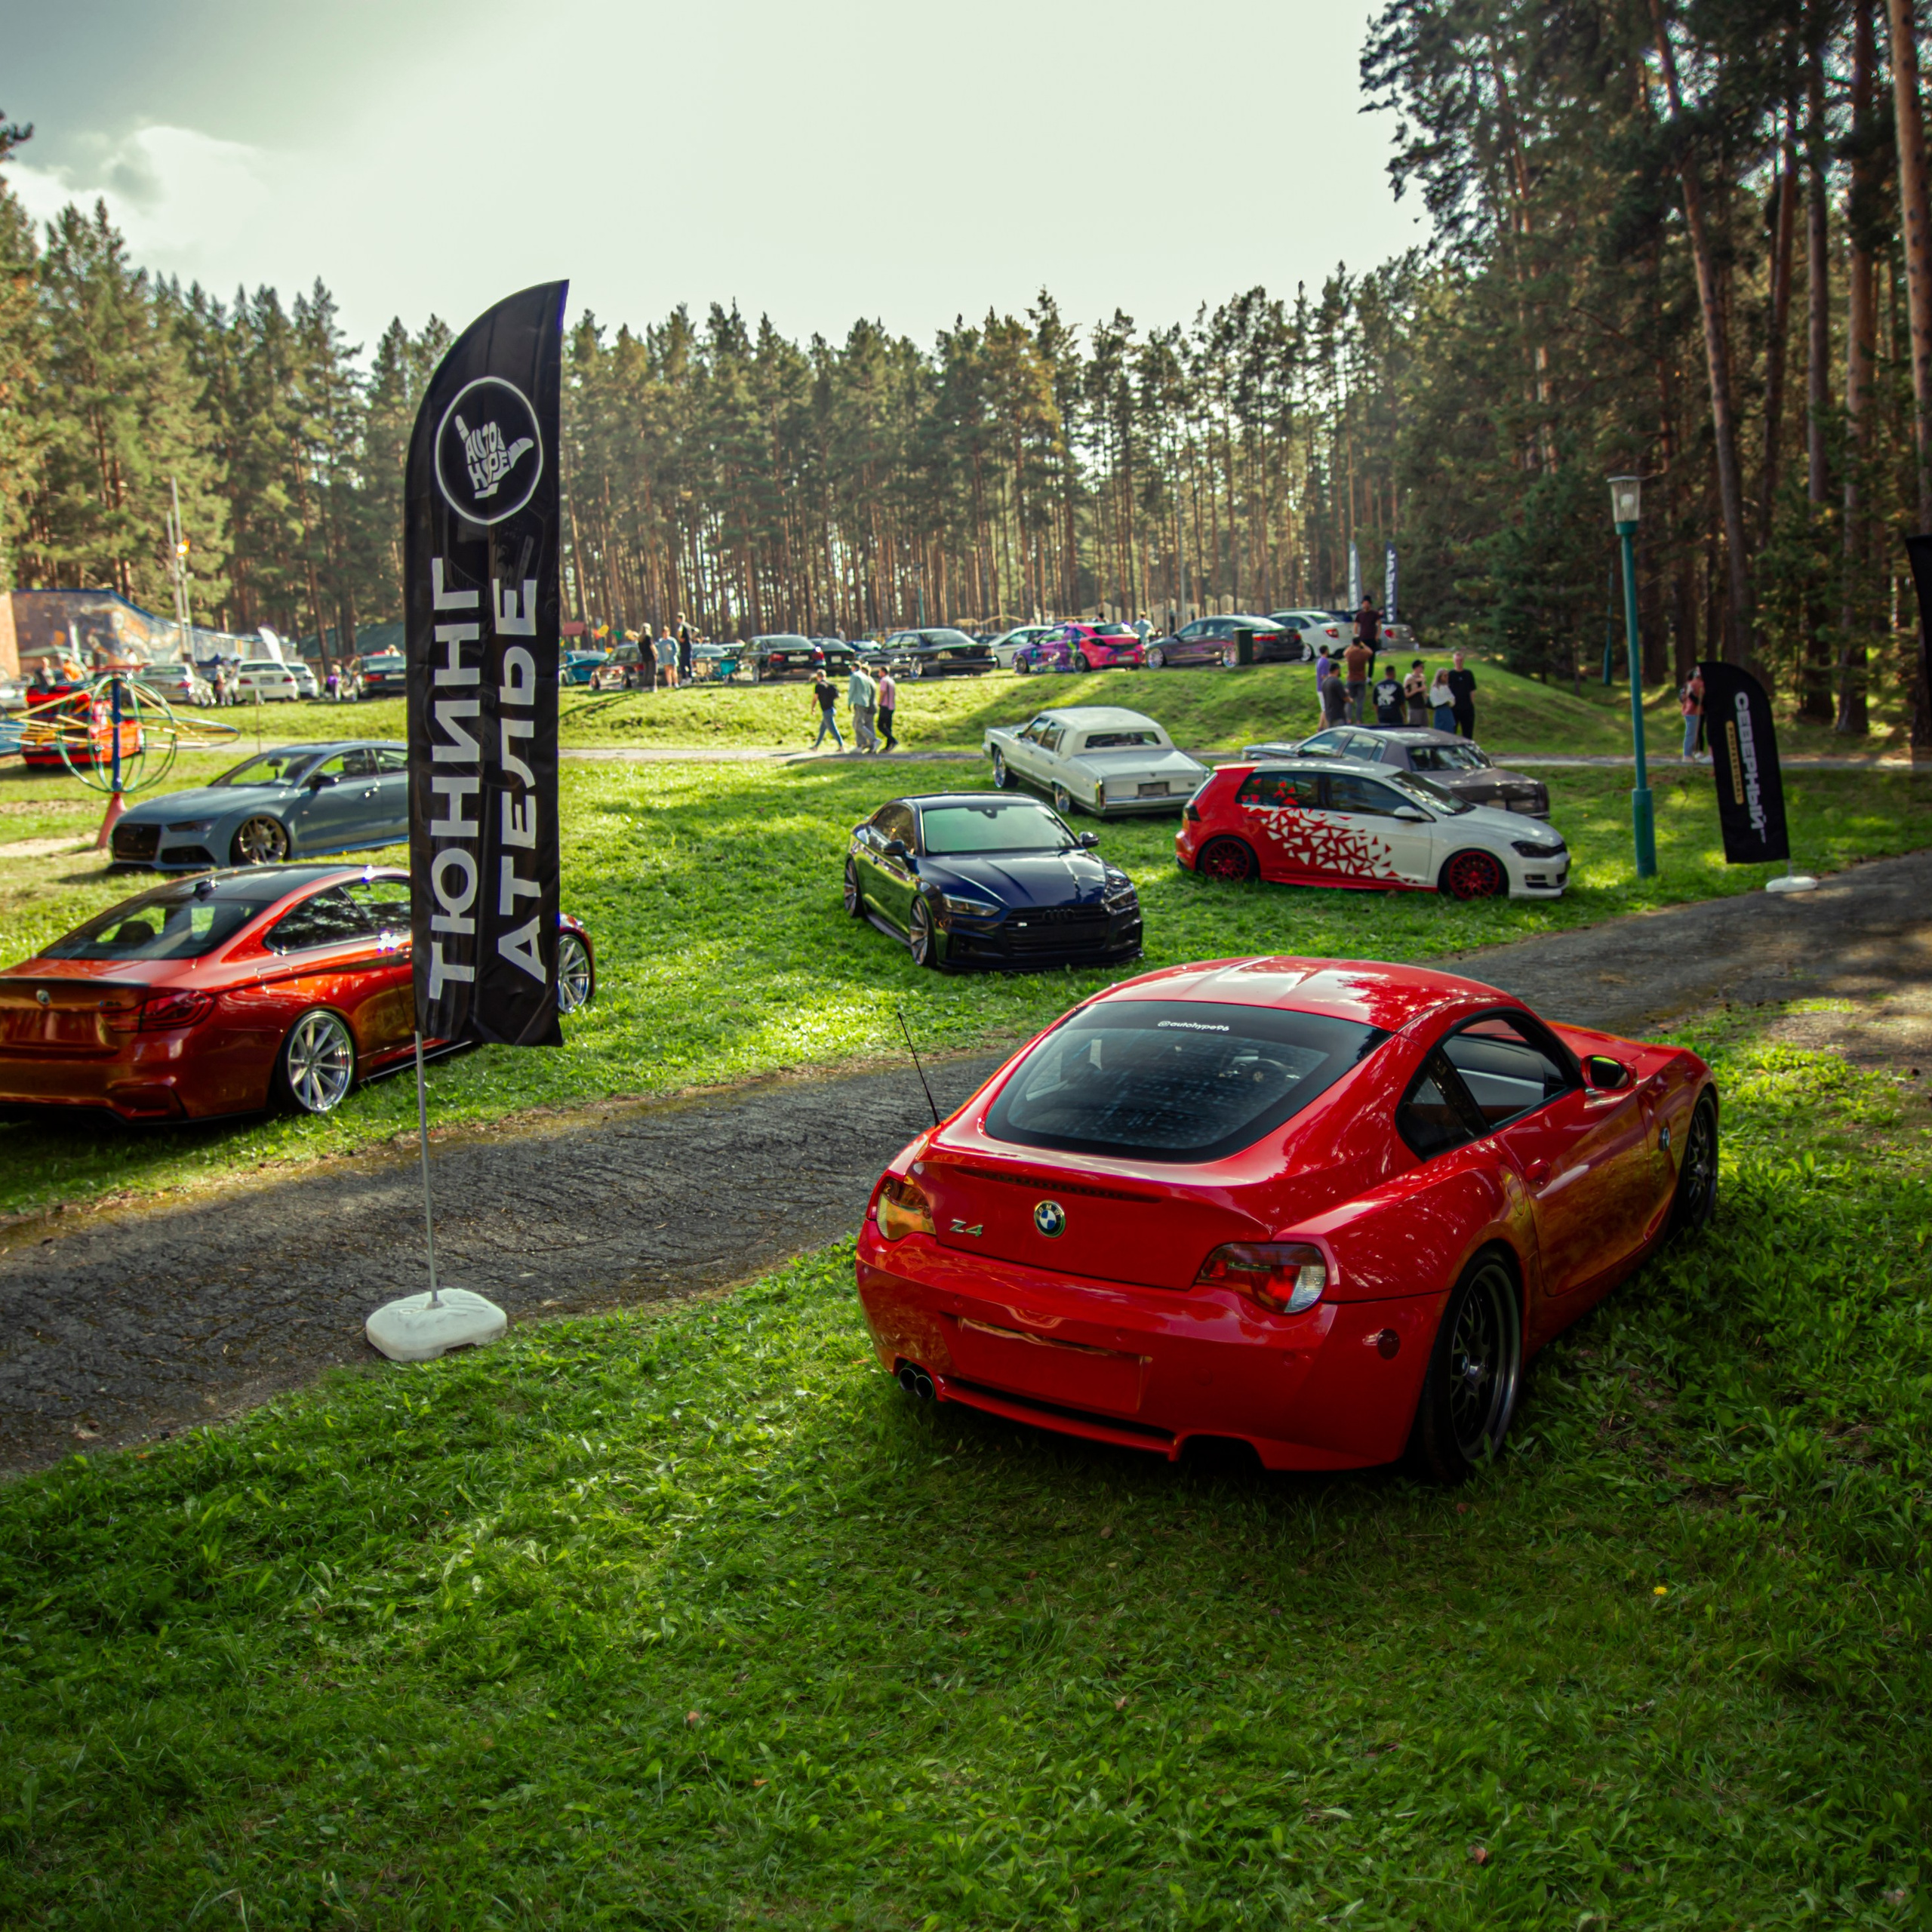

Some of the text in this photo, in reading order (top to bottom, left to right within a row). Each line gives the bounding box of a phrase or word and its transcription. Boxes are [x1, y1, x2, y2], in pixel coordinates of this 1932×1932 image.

[429, 557, 480, 999] ТЮНИНГ
[492, 577, 546, 985] АТЕЛЬЕ
[1727, 726, 1742, 799] PROFESSIONAL
[1735, 691, 1767, 830] СЕВЕРНЫЙ
[1157, 1020, 1230, 1032] @autohype96
[949, 1218, 983, 1237] Z4
